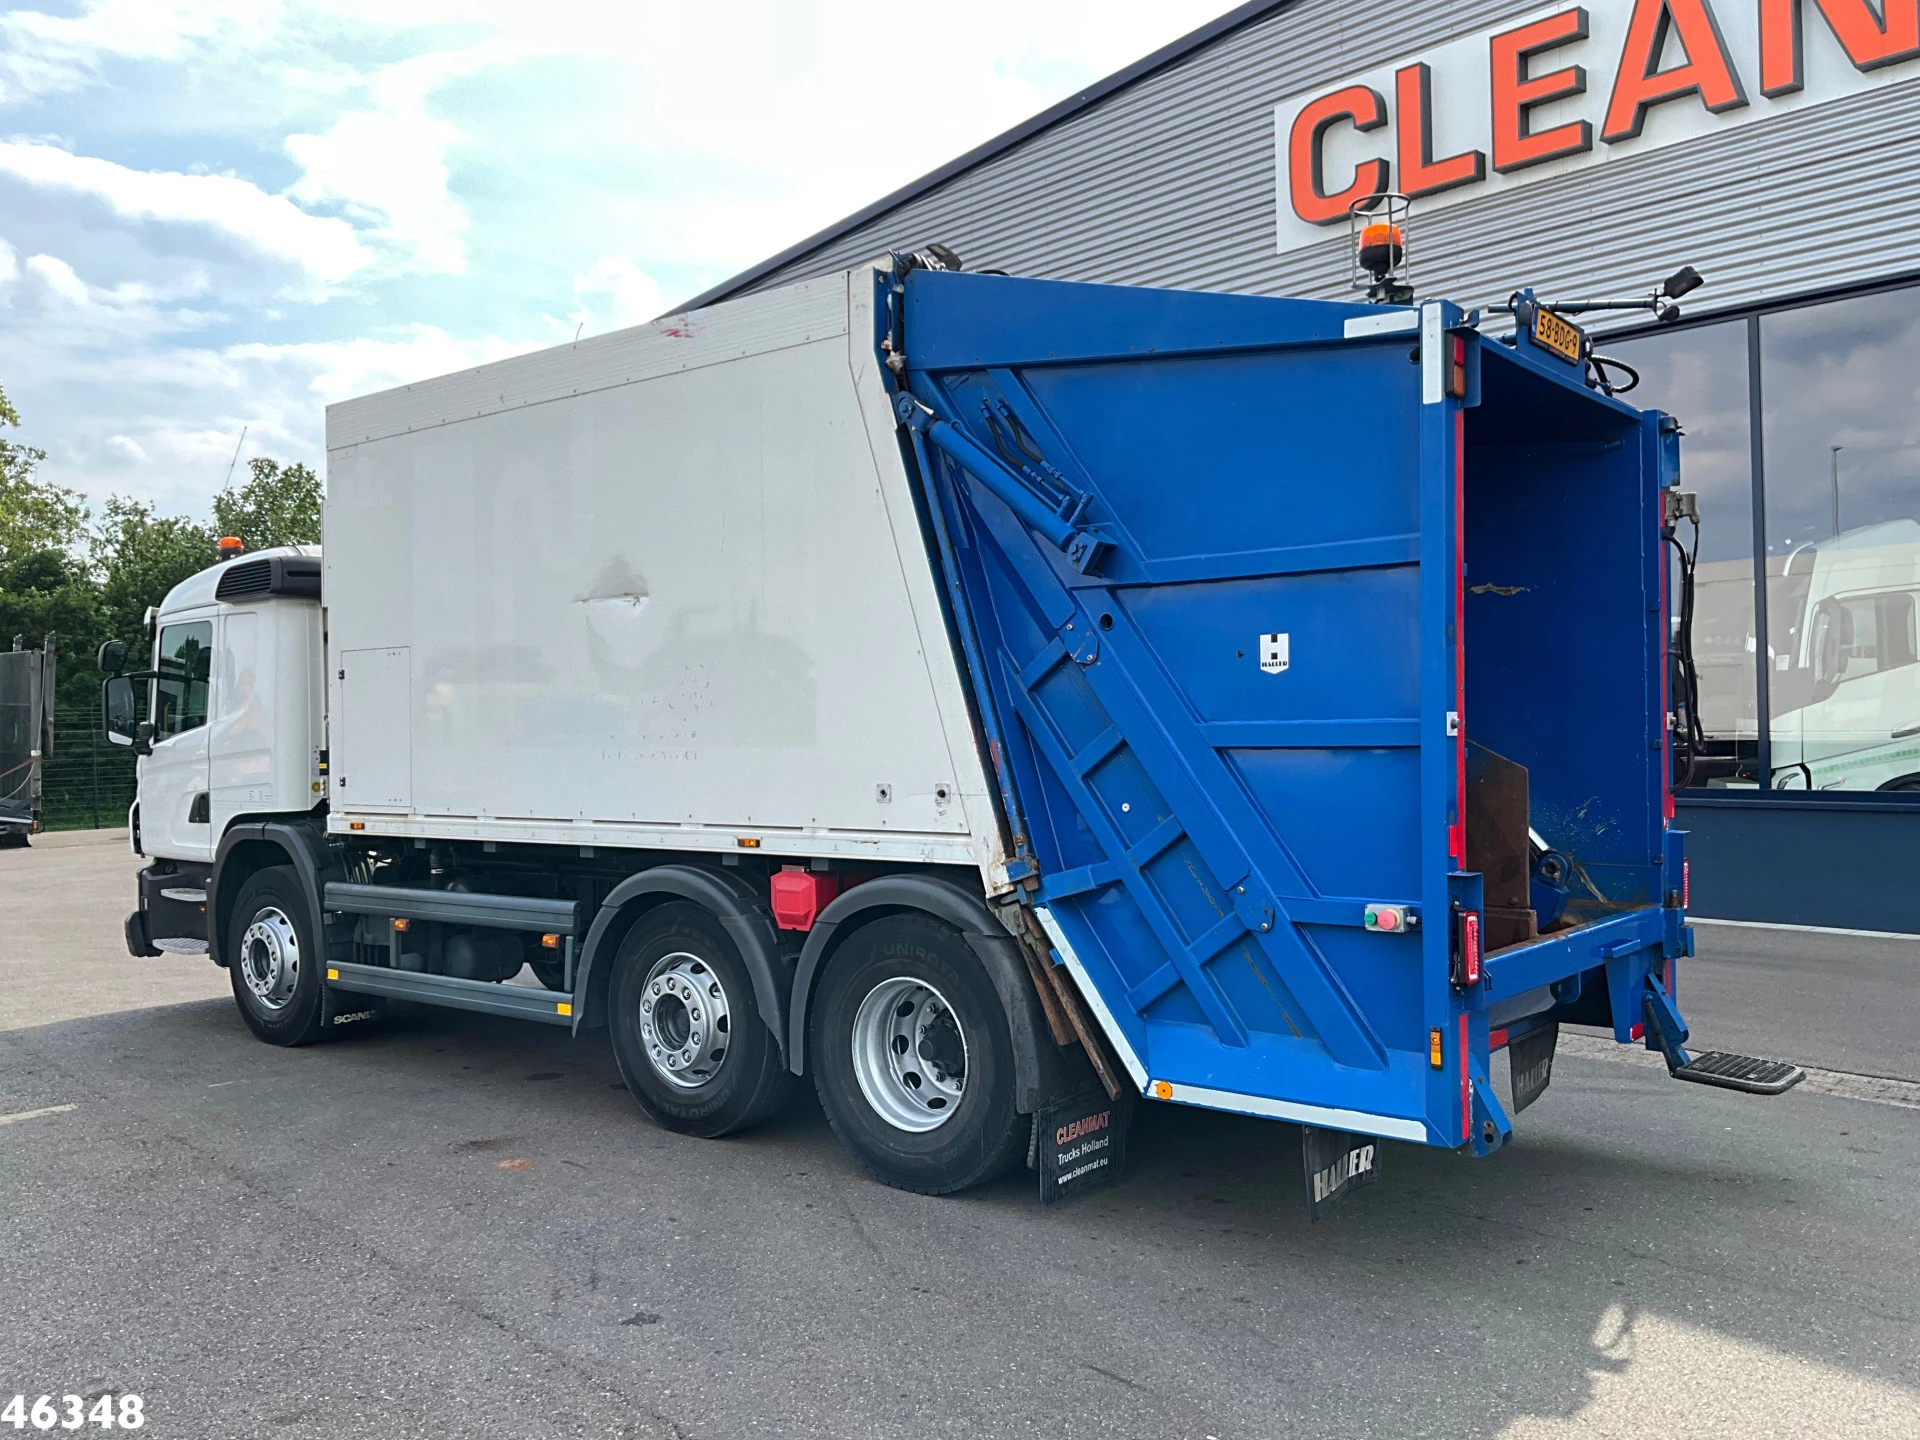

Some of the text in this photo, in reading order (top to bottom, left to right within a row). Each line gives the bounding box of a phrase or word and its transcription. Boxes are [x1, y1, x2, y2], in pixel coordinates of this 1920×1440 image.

[1538, 314, 1578, 355] 58-BDG-9
[1056, 1110, 1111, 1145] CLEANMAT
[1058, 1135, 1109, 1166] Trucks Holland
[1057, 1157, 1108, 1185] www.cleanmat.eu
[1313, 1144, 1375, 1203] HALLER
